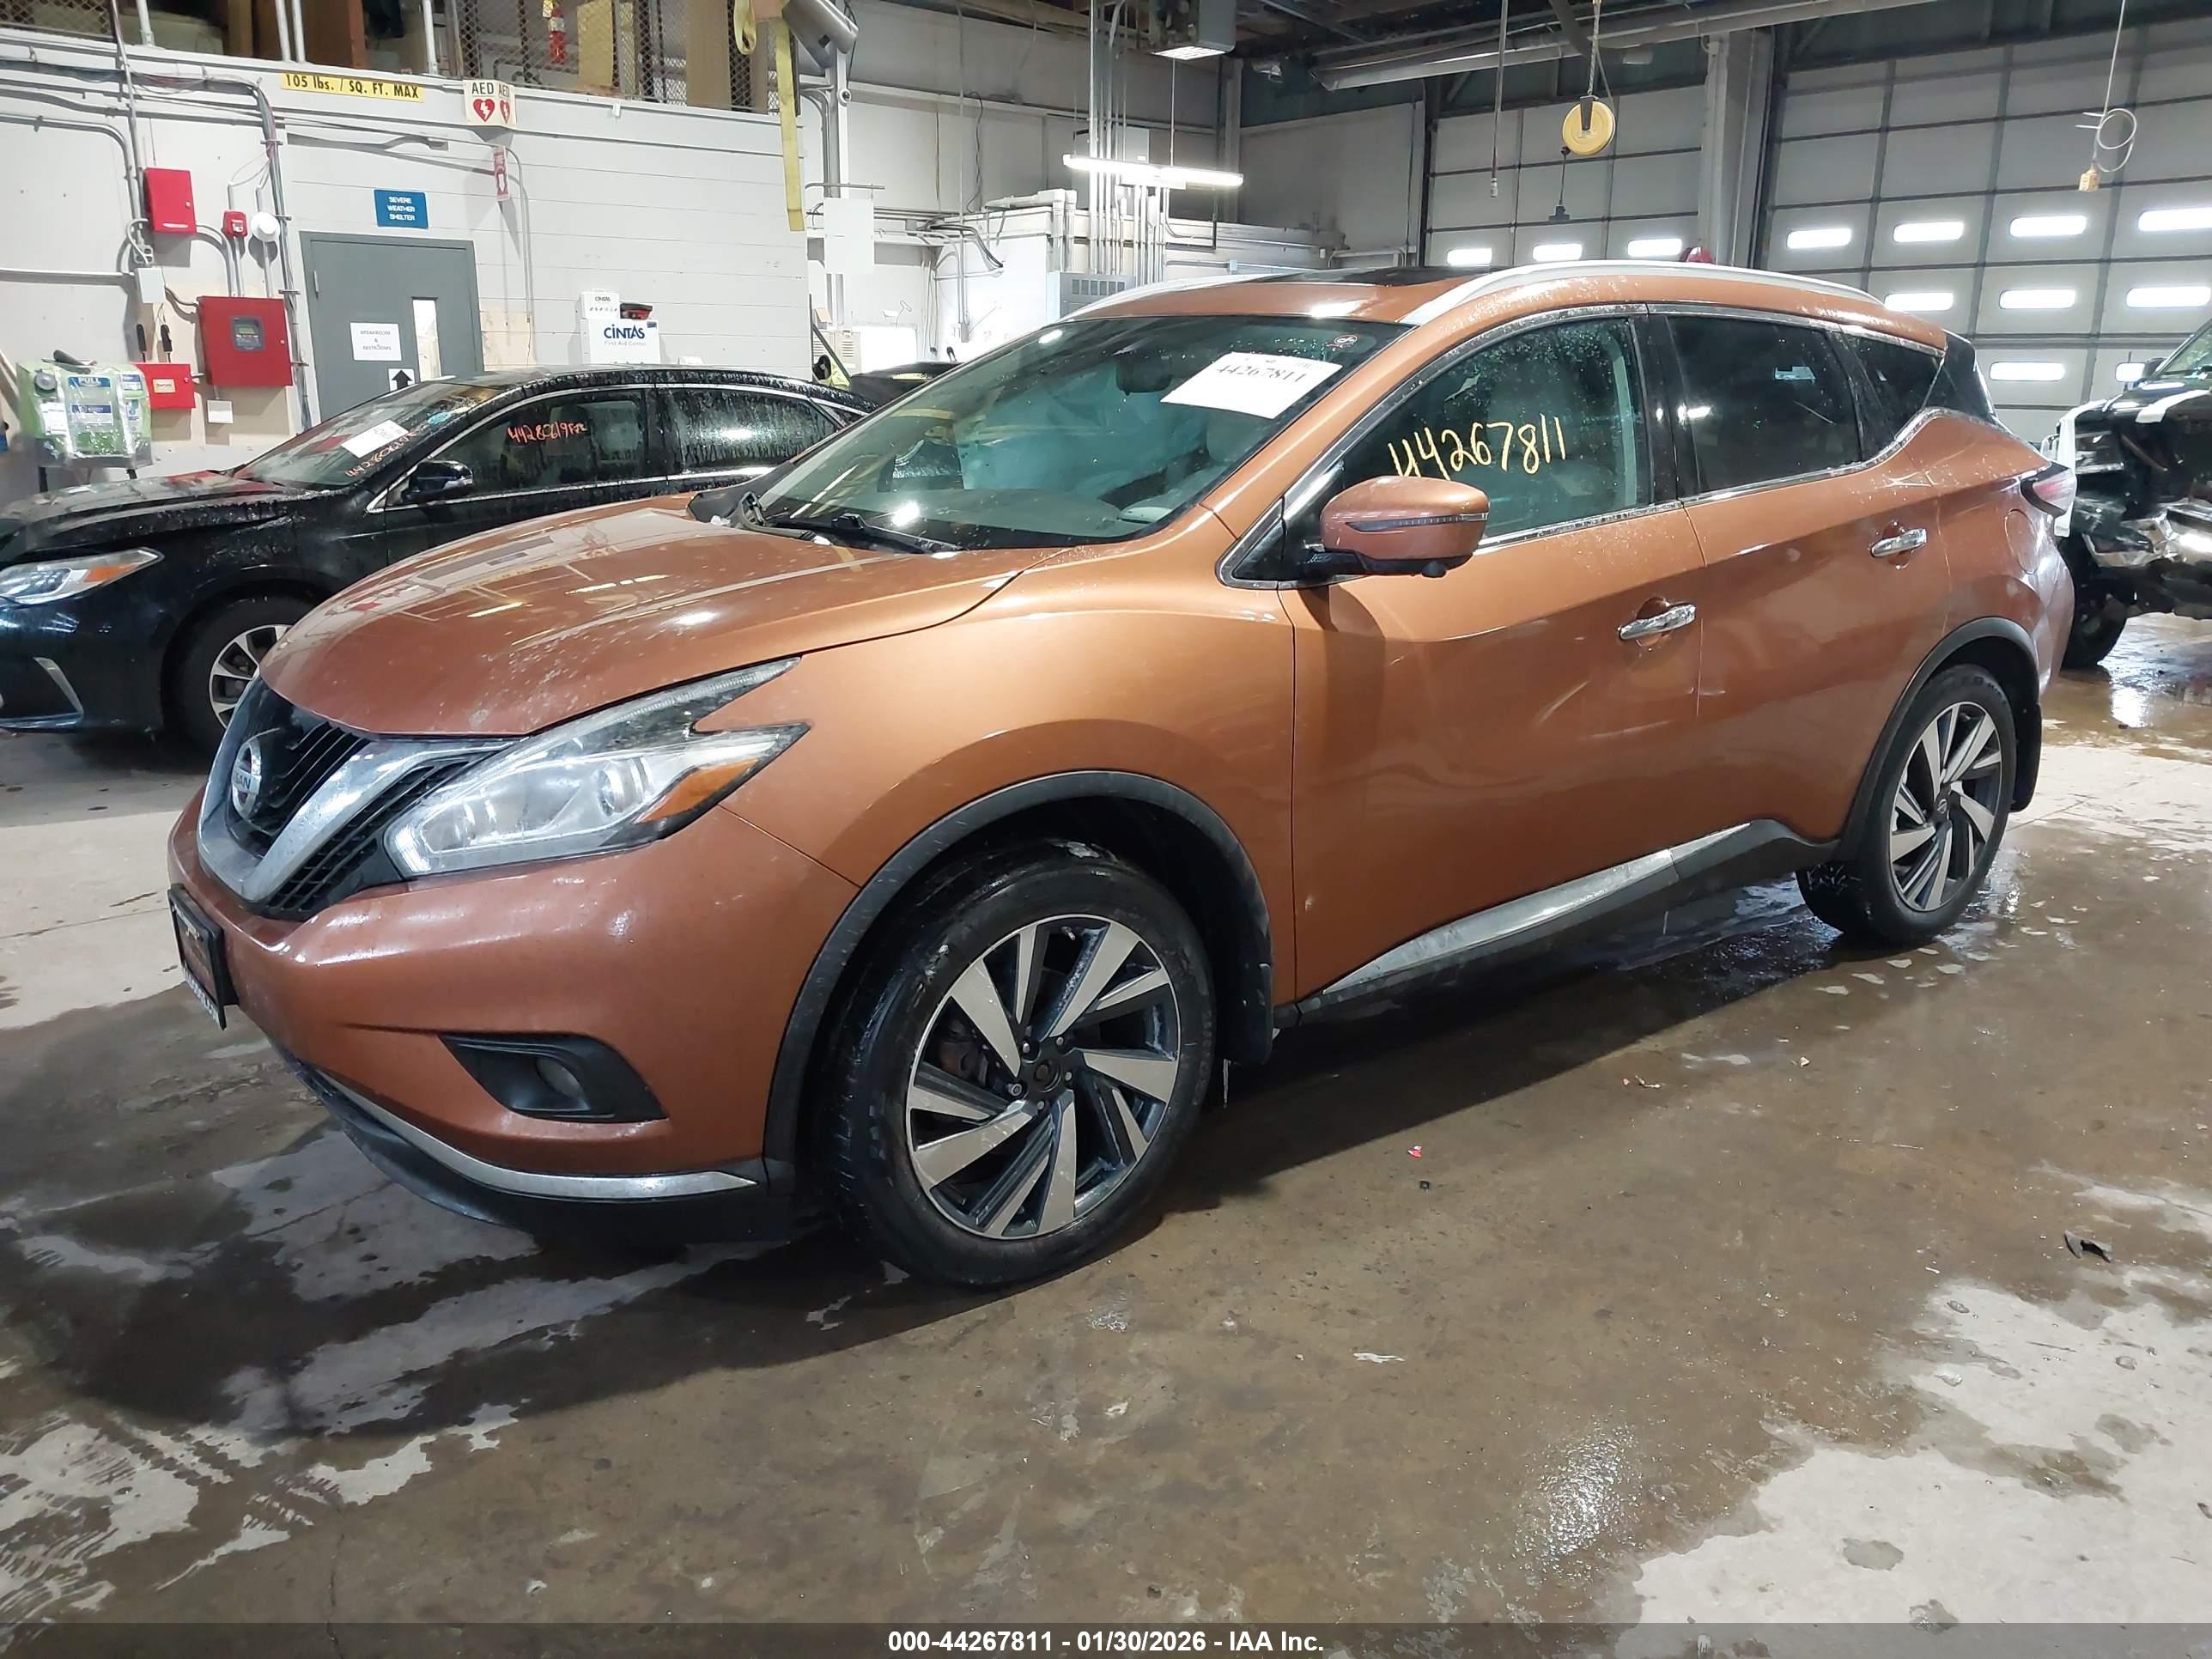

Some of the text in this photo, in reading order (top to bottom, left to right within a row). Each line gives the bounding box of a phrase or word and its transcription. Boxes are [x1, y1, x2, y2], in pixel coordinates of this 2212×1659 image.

[286, 74, 308, 88] 105
[313, 75, 335, 91] lbs.
[349, 80, 368, 94] SQ.
[373, 82, 389, 96] FT.
[393, 83, 419, 99] MAX
[471, 82, 494, 94] AED
[498, 83, 510, 98] AED
[386, 204, 416, 213] WEATHER
[389, 213, 416, 222] SHELTER
[1387, 412, 1566, 481] 44267811
